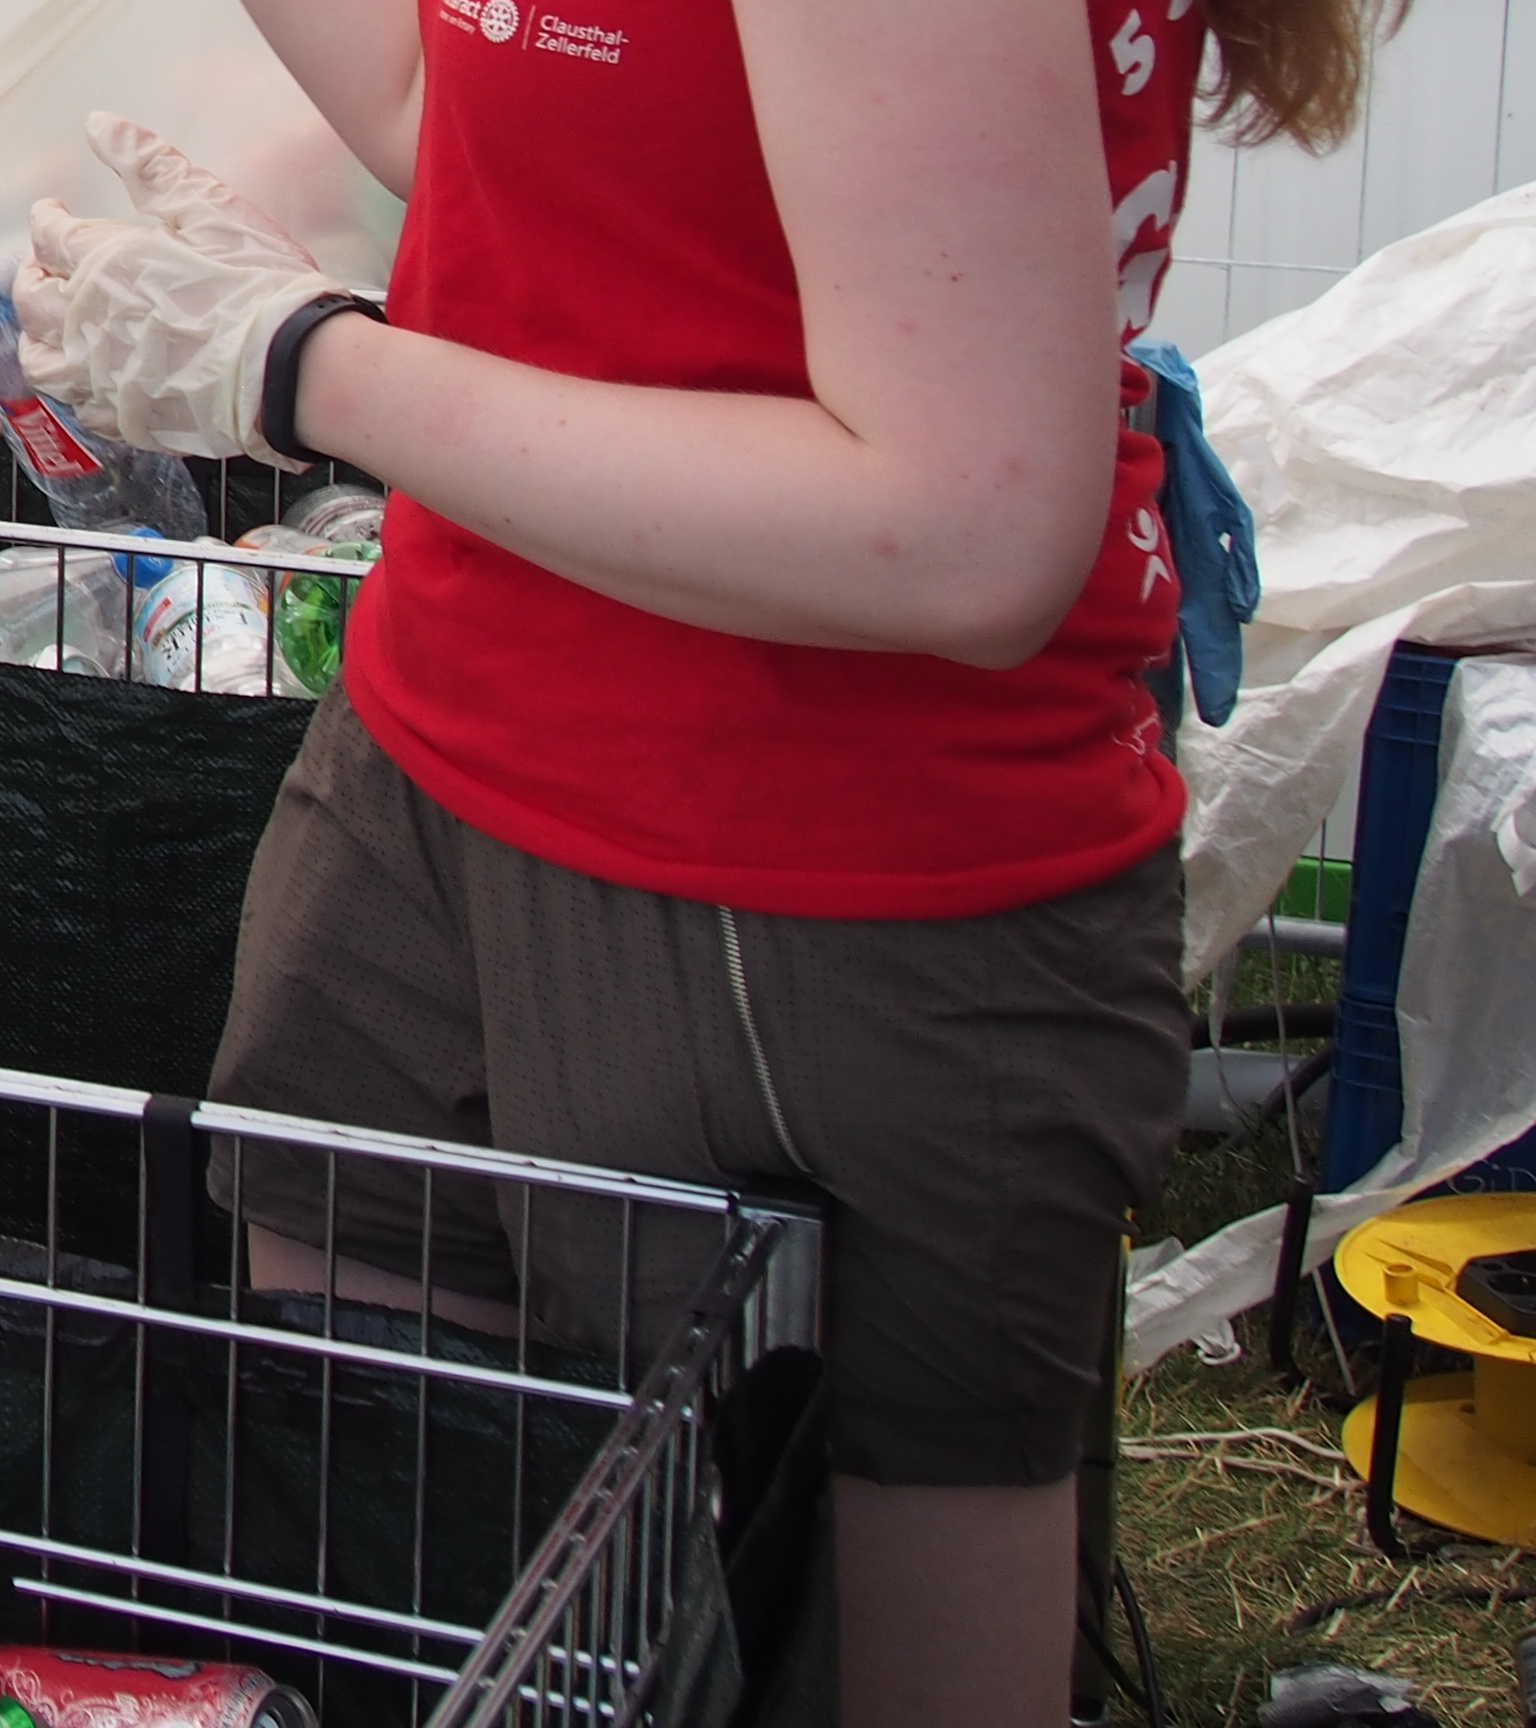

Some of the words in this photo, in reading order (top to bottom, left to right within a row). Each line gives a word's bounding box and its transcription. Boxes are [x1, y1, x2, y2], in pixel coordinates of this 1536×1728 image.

[540, 15, 630, 45] Clausthal-
[535, 32, 620, 64] Zellerfeld
[1109, 9, 1156, 96] 5
